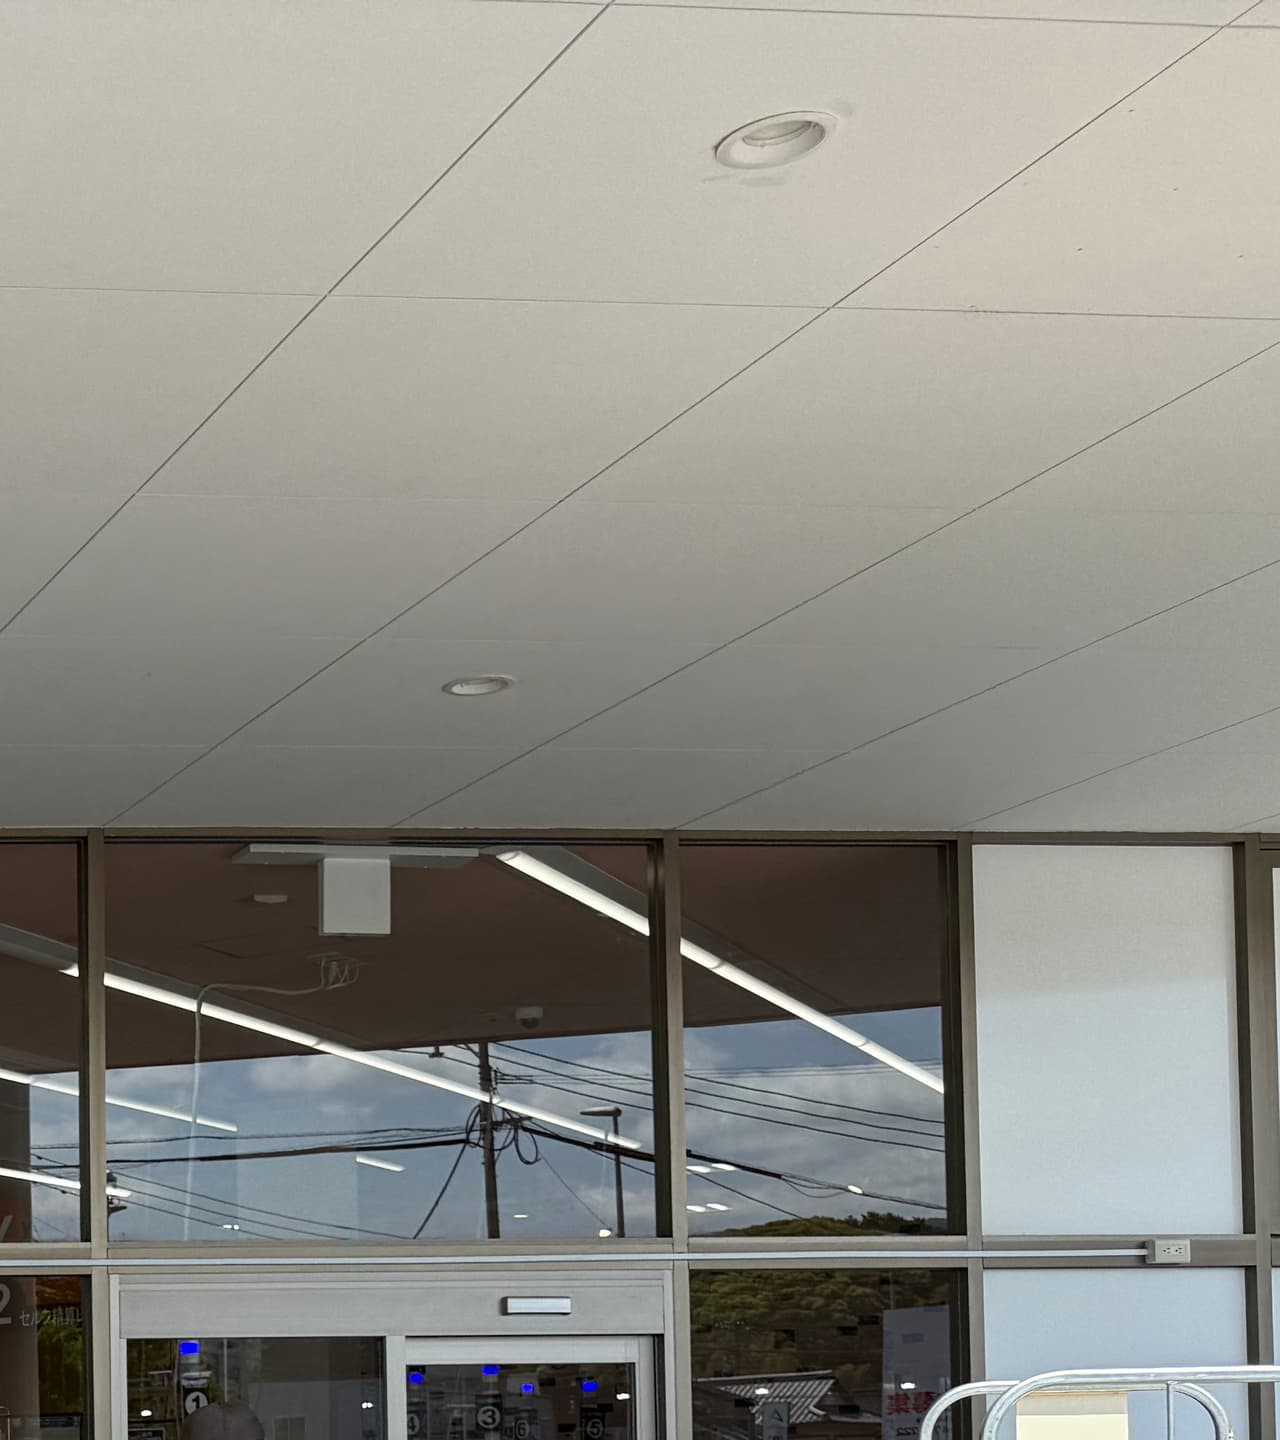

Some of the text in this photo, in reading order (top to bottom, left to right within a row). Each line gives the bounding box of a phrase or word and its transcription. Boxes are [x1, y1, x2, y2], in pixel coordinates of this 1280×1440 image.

[19, 1310, 82, 1328] セルフ精算レ
